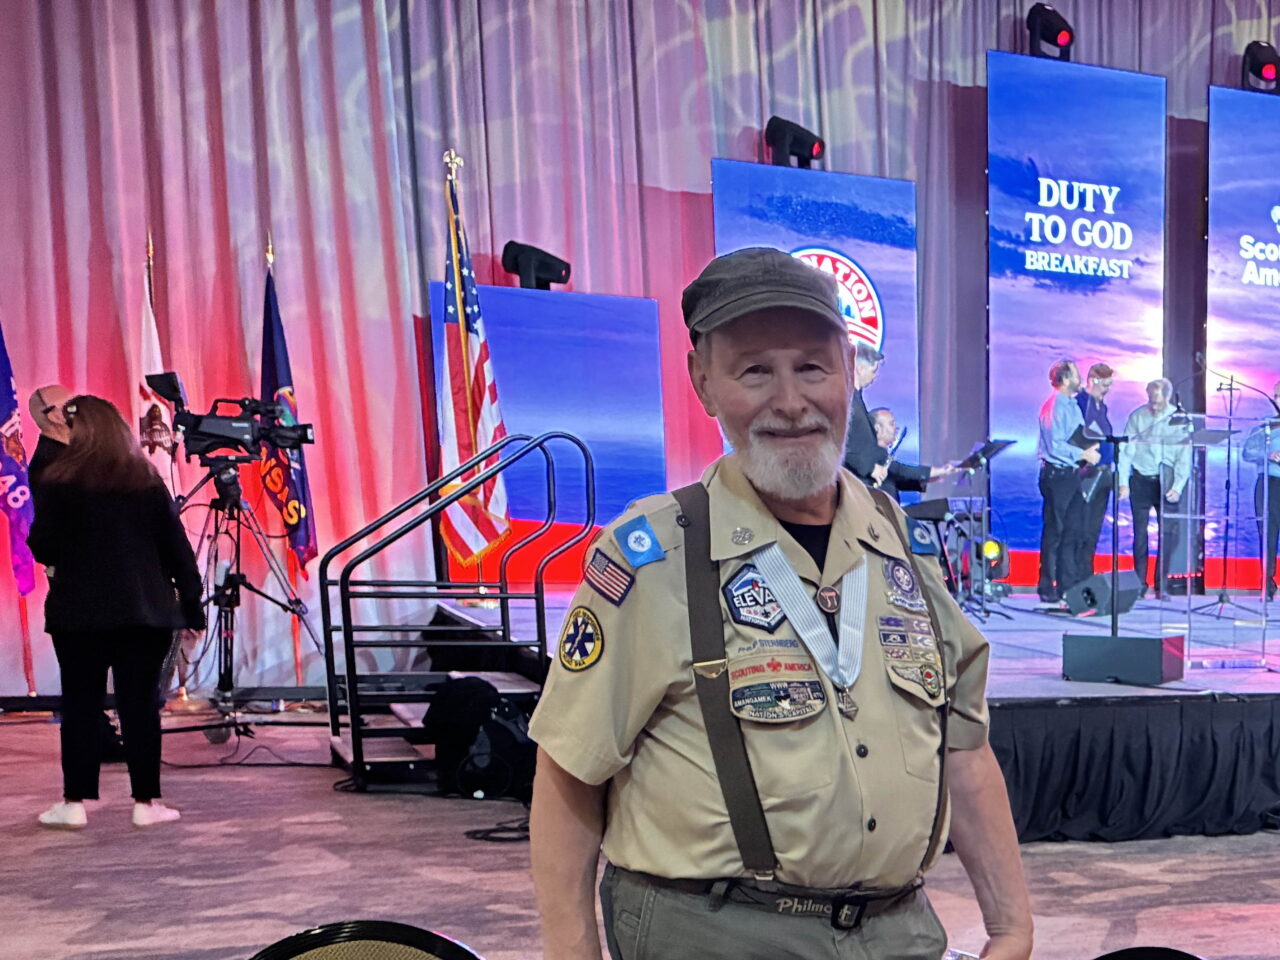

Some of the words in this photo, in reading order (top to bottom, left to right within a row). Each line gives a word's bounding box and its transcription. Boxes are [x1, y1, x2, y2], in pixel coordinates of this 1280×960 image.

[1038, 177, 1120, 214] DUTY
[1025, 212, 1066, 244] TO
[1071, 217, 1133, 250] GOD
[1024, 249, 1133, 279] BREAKFAST
[733, 588, 776, 608] ELEVA
[731, 665, 766, 680] SCOUTING
[784, 663, 814, 672] AMERICA
[776, 897, 833, 914] Philmo
